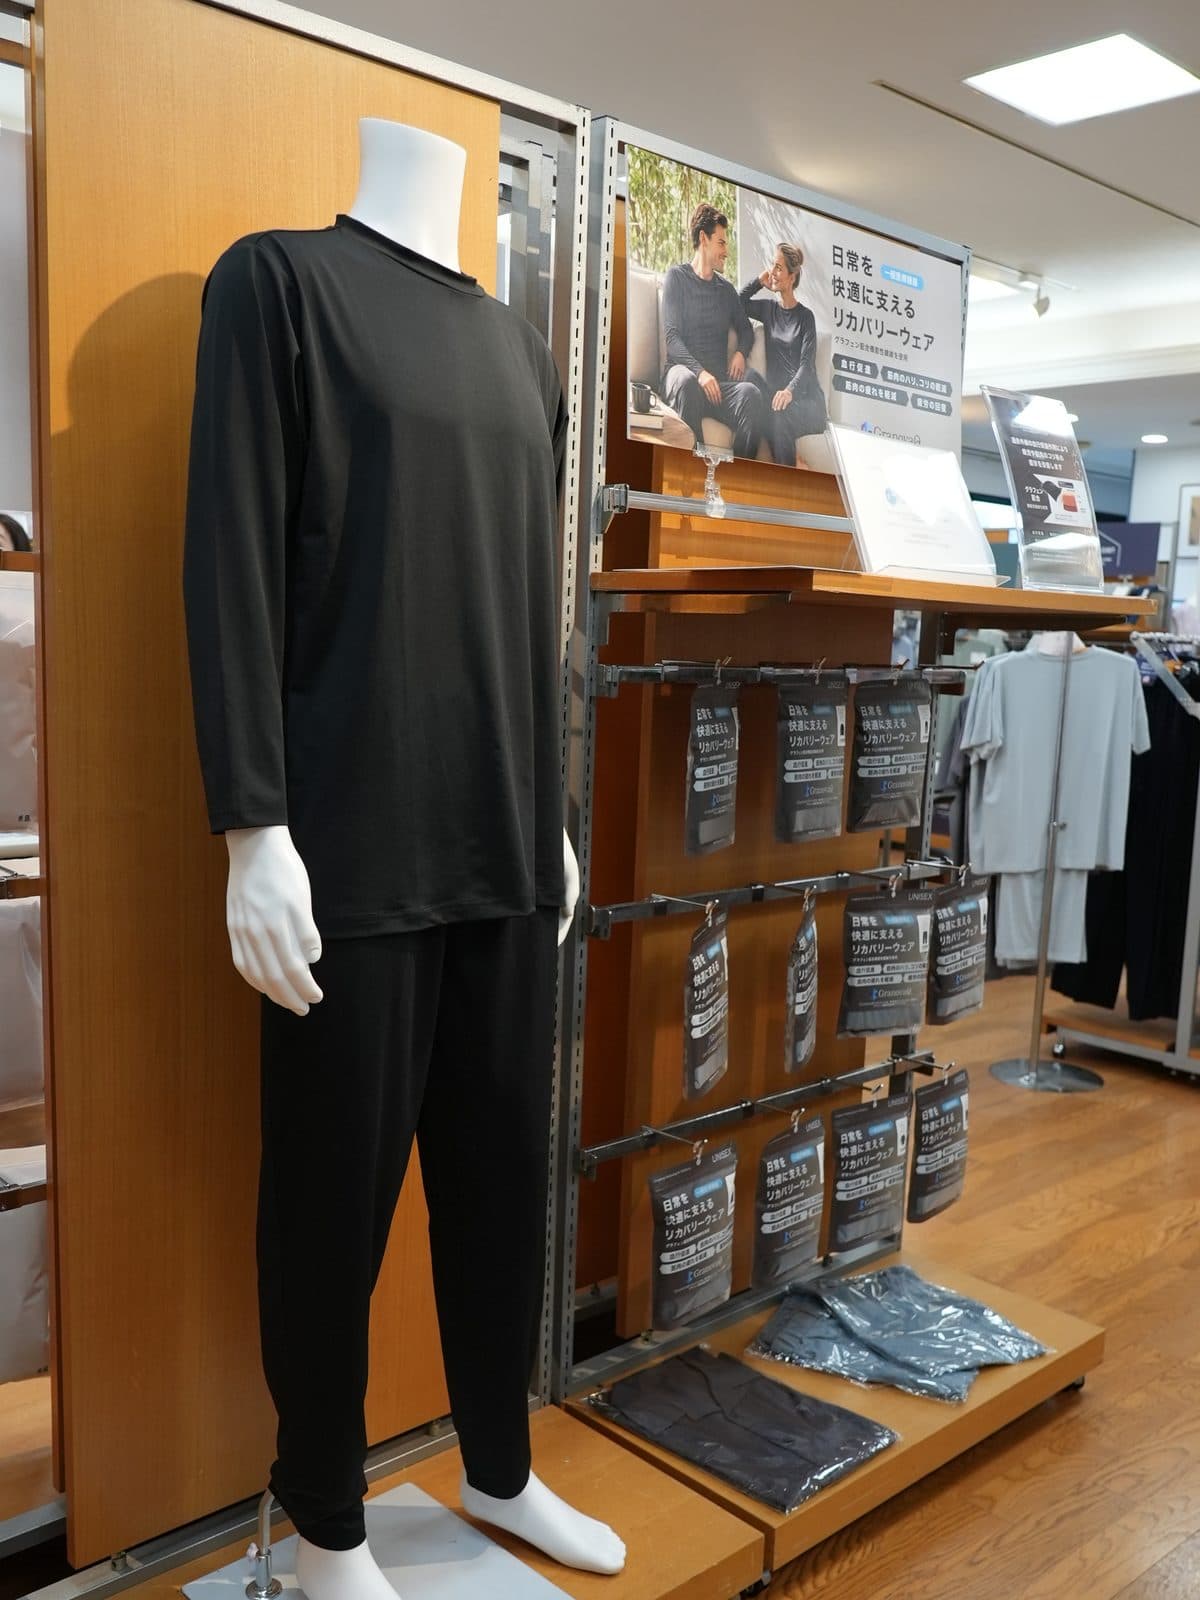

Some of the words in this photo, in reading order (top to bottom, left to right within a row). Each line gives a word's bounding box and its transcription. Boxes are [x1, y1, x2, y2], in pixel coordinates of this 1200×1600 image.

[832, 244, 873, 277] 日常を
[831, 275, 915, 319] 快適に支える
[833, 307, 935, 351] リカバリーウェア
[860, 706, 882, 717] 日常を
[788, 719, 828, 731] 快適に支える
[862, 718, 907, 731] 快適に支える
[789, 734, 835, 748] リカバリーウェア
[863, 731, 917, 745] リカバリーウェア
[908, 893, 933, 901] UNISEX
[852, 916, 879, 927] 日常を
[936, 907, 954, 920] 日常を
[938, 916, 971, 934] 快適に支える
[852, 928, 903, 941] 快適に支える
[939, 926, 979, 945] リカバリーウェア
[852, 941, 915, 955] リカバリーウェア
[841, 1129, 863, 1144] 日常を
[840, 1137, 886, 1157] 快適に支える
[767, 1157, 786, 1173] 日常を
[841, 1147, 894, 1170] リカバリーウェア
[766, 1164, 808, 1187] 快適に支える
[766, 1174, 817, 1201] リカバリーウェア
[663, 1193, 689, 1213] 日常を
[664, 1198, 714, 1226] 快適に支える
[665, 1208, 725, 1240] リカバリーウェア
